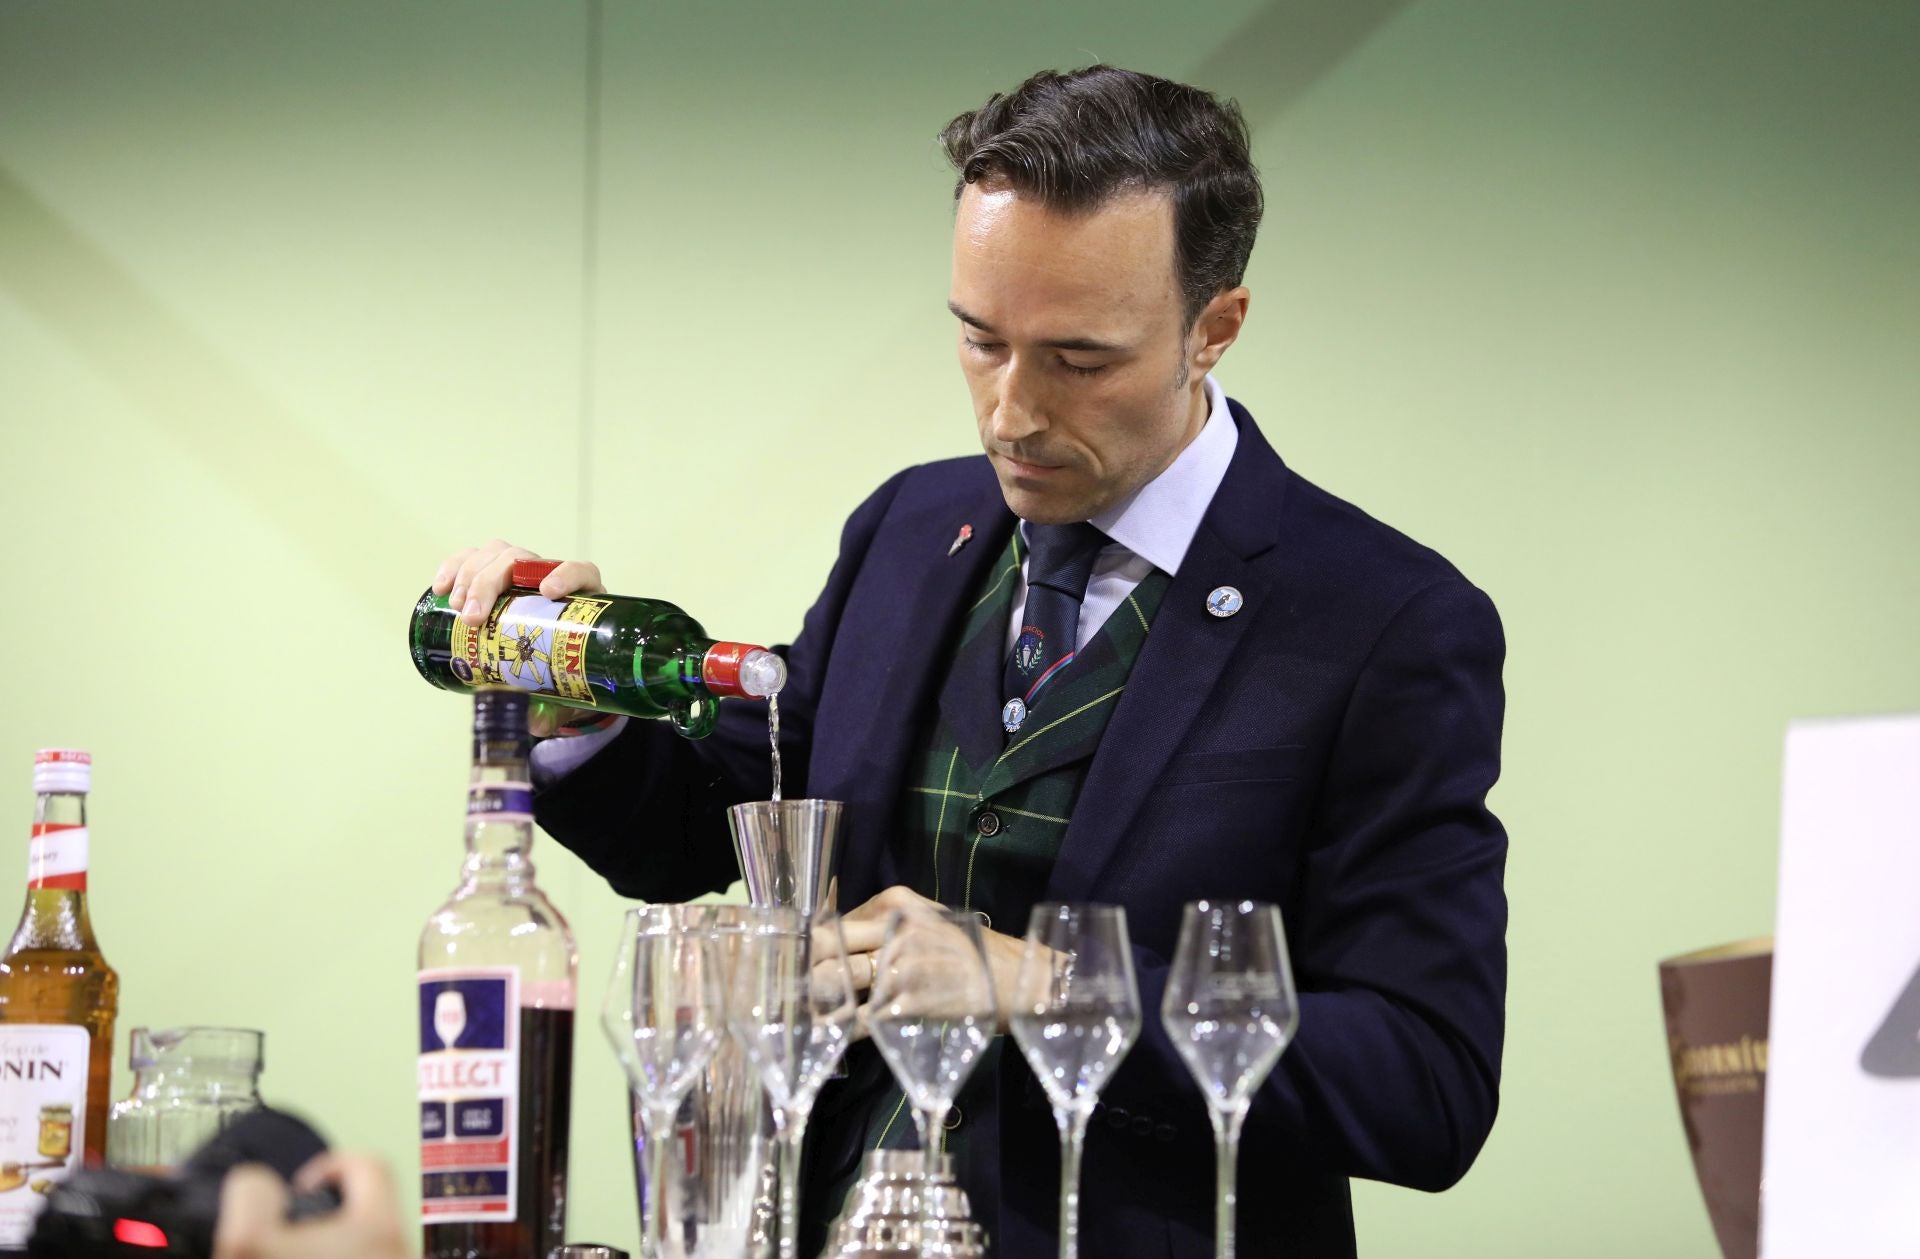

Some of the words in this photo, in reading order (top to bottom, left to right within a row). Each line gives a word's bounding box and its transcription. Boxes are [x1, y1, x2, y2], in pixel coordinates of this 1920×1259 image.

[467, 626, 480, 669] HON
[0, 1059, 62, 1080] NIN
[419, 1060, 504, 1089] ELECT
